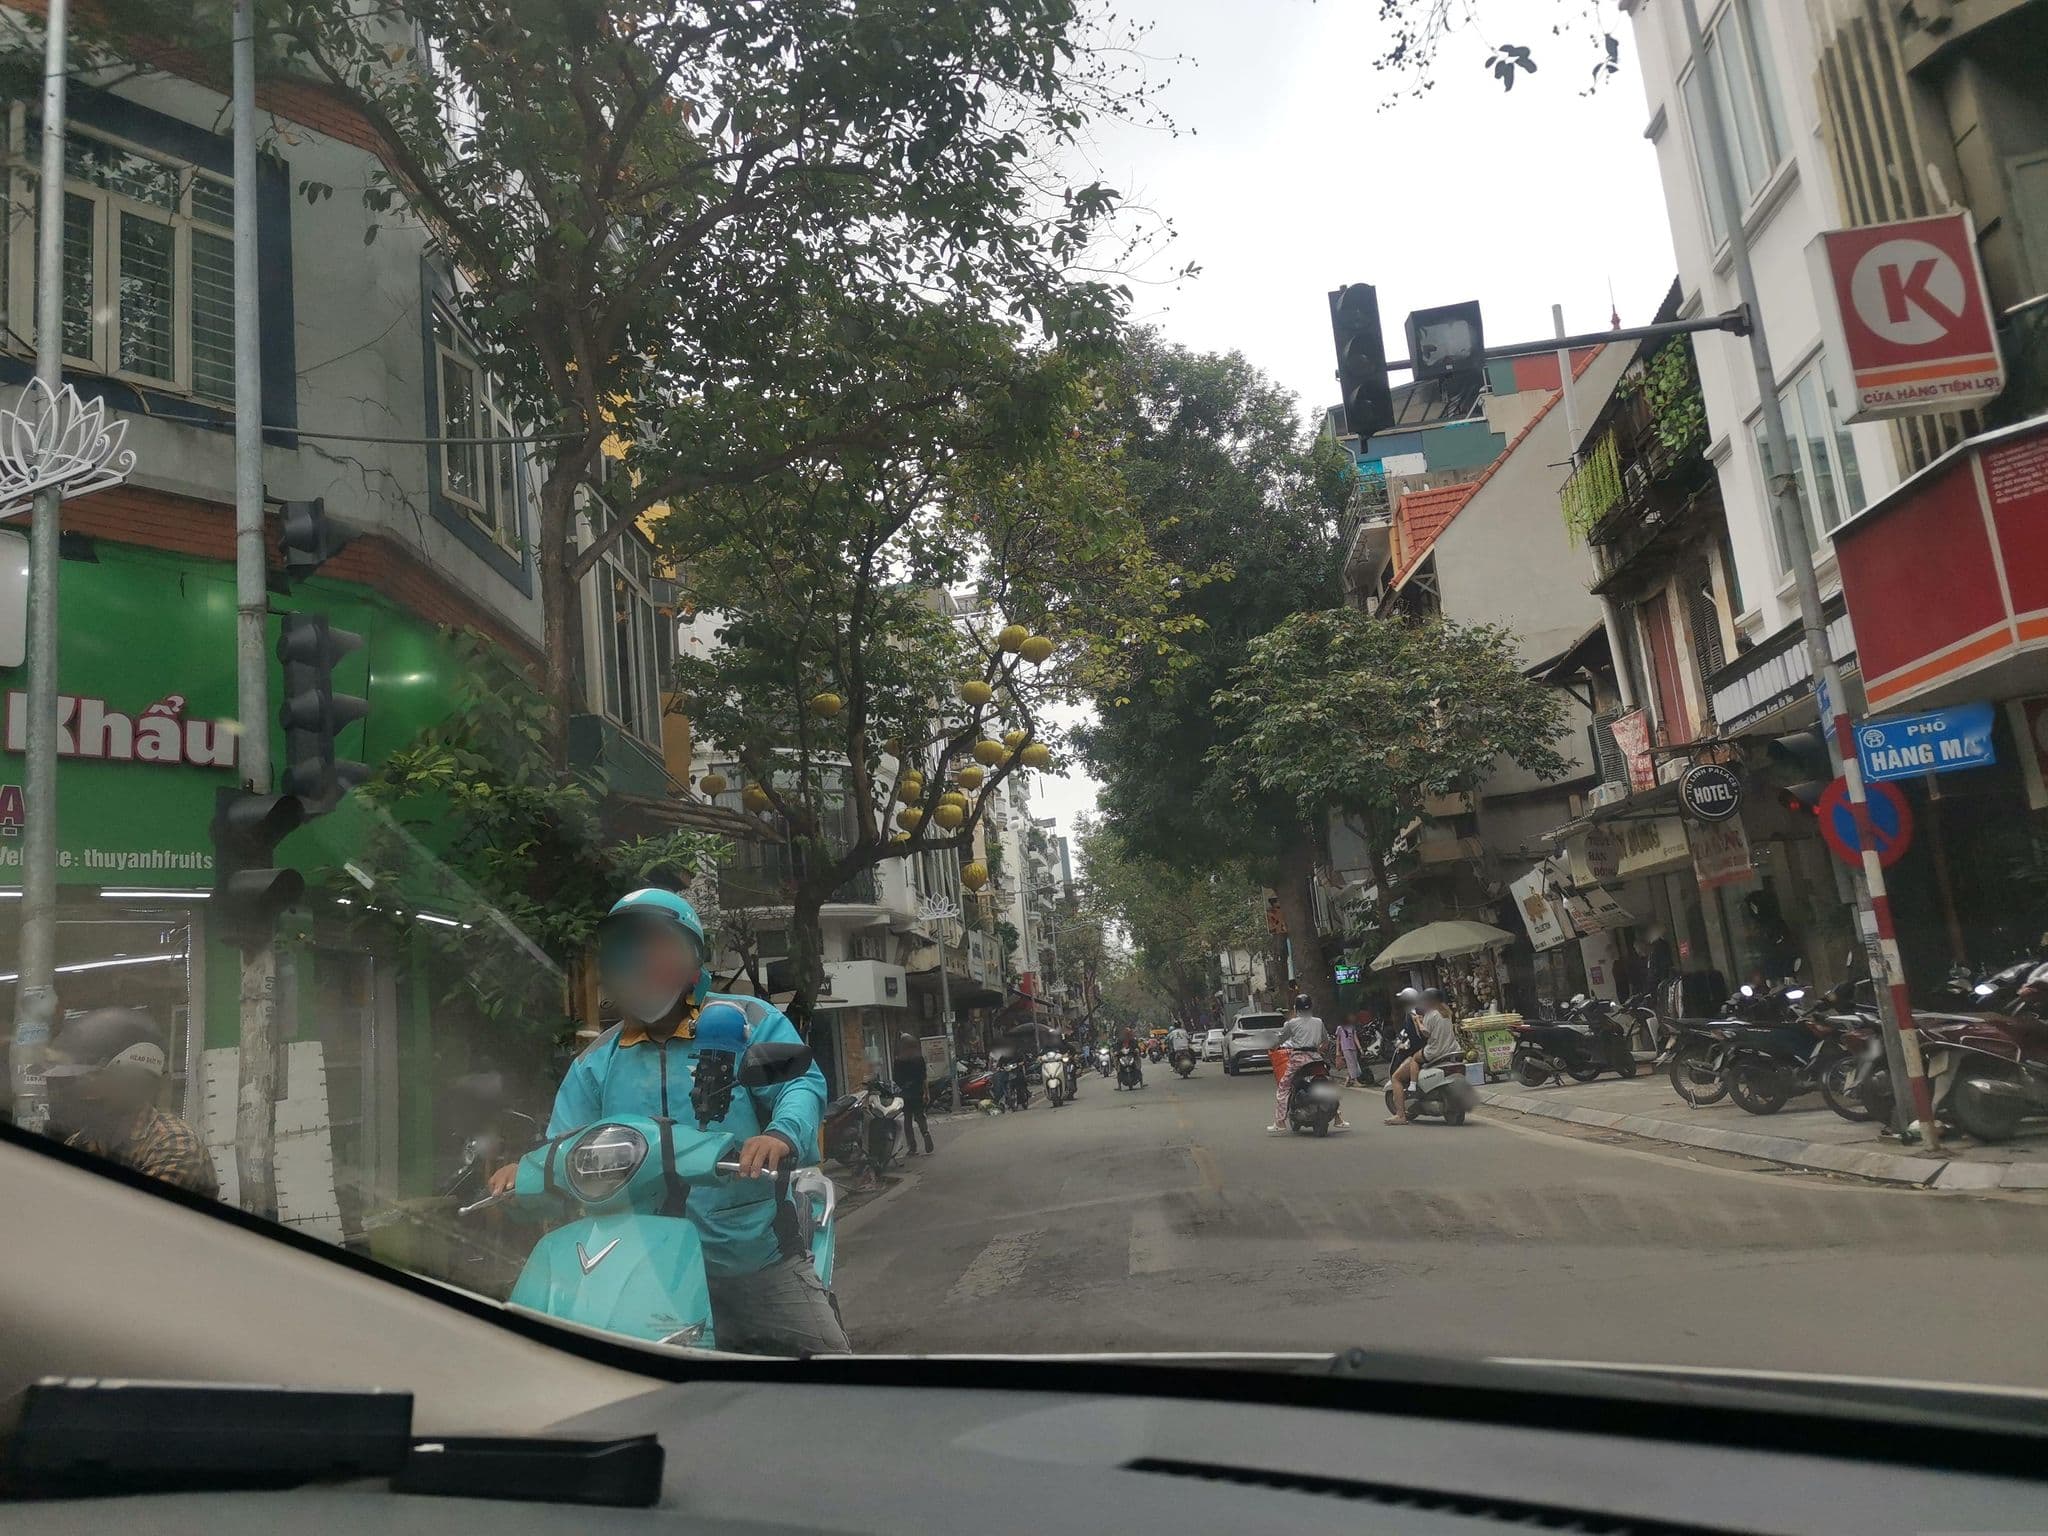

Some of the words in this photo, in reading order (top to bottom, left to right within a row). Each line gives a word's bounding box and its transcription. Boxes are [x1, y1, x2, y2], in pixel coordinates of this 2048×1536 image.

[1878, 257, 1962, 332] K
[1863, 389, 1895, 404] CỬA
[1897, 383, 1938, 400] HÀNG
[8, 690, 239, 768] Khẩu
[1870, 744, 1935, 772] HÀNG
[1708, 767, 1738, 787] PALACE
[1693, 783, 1733, 804] HOTEL
